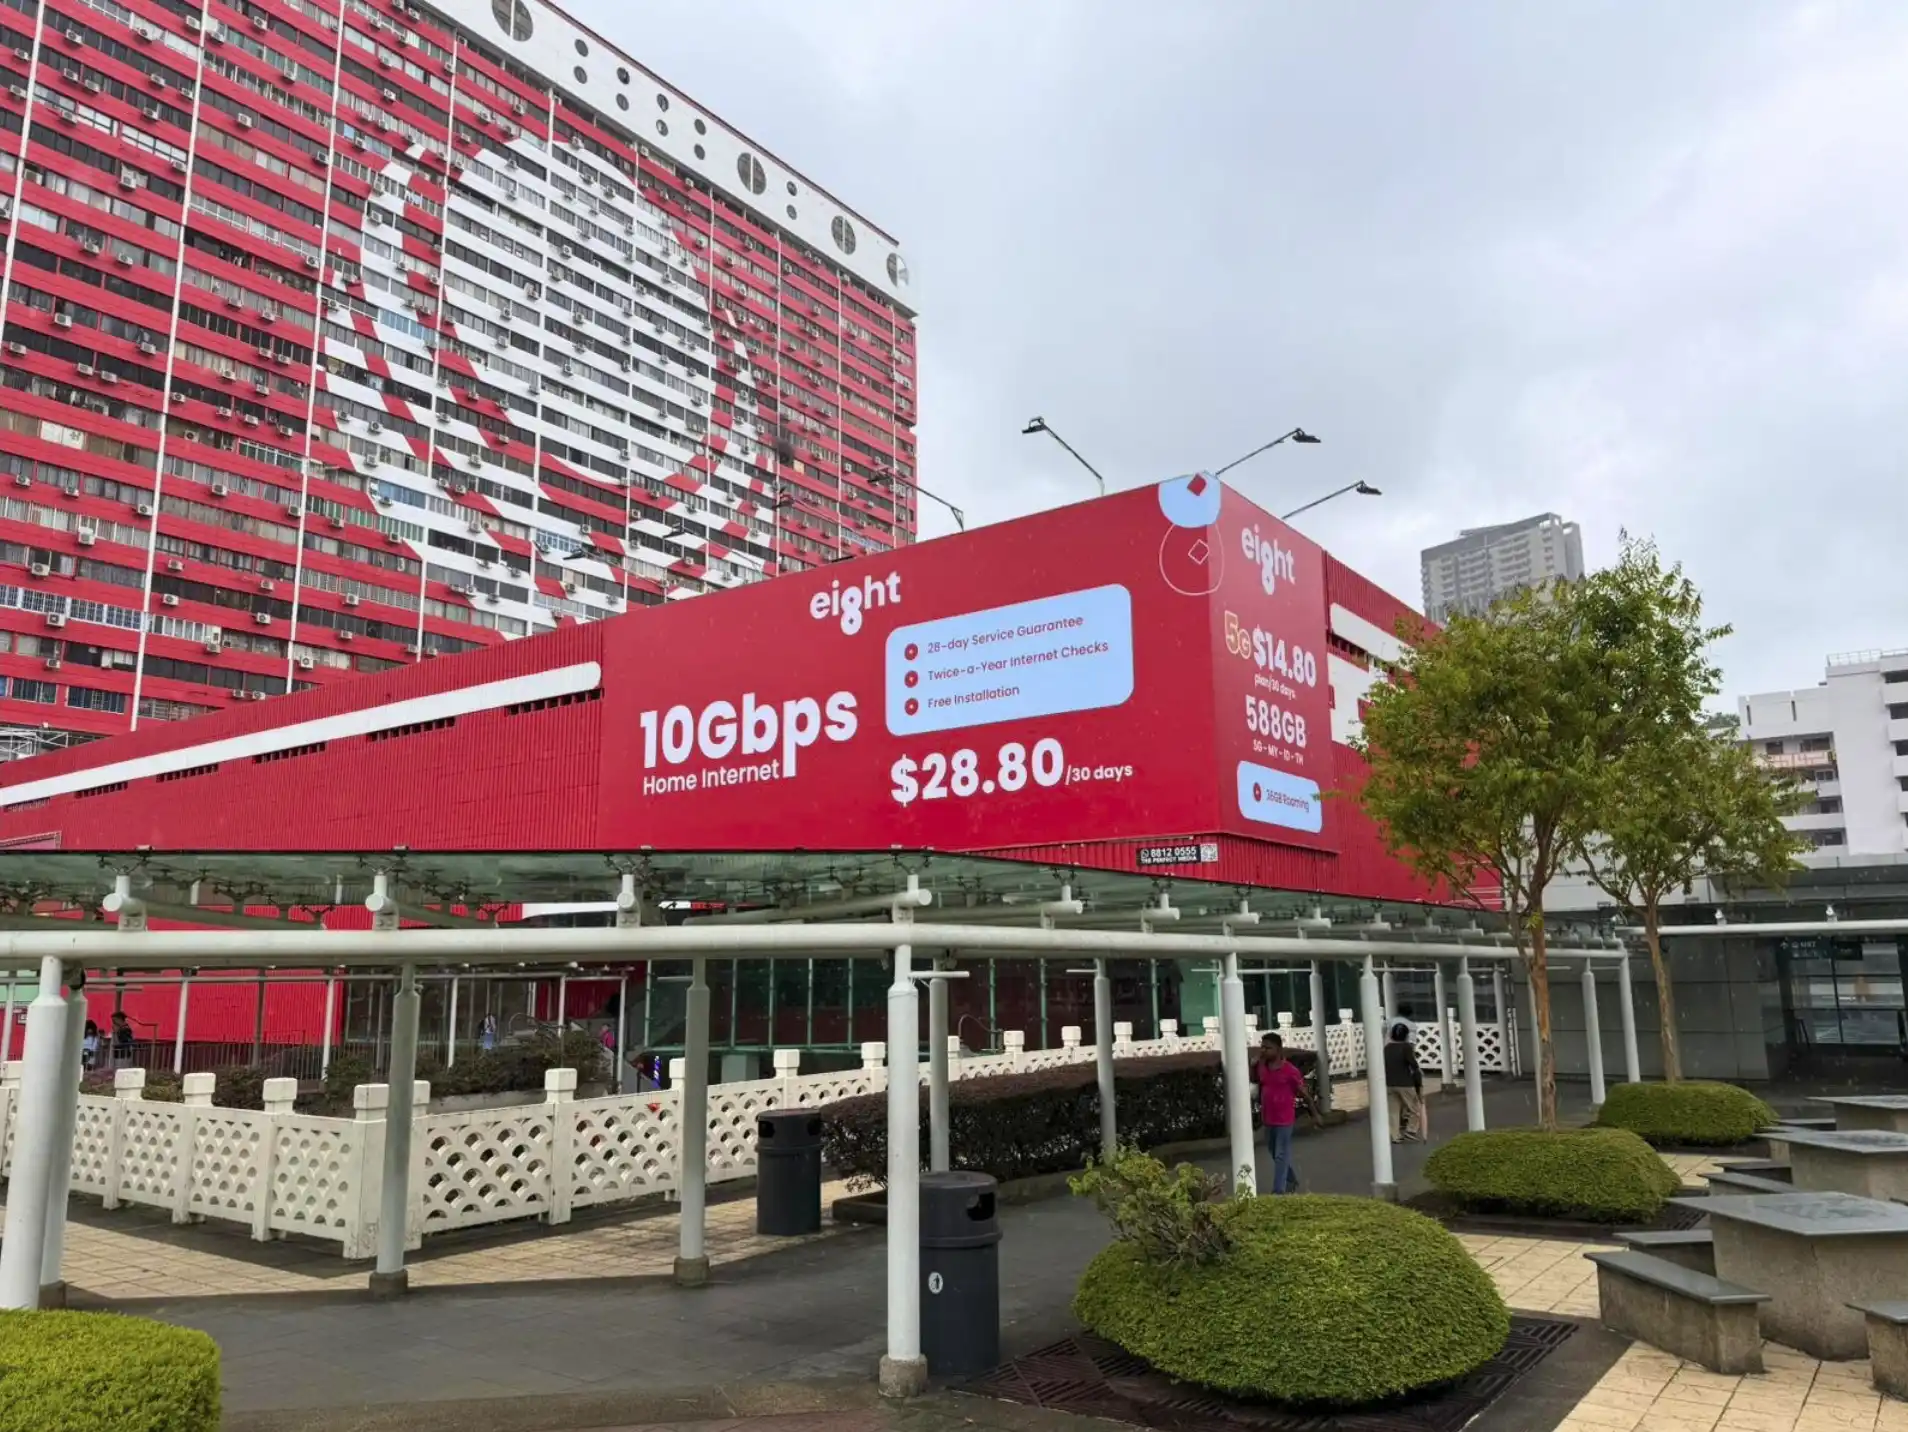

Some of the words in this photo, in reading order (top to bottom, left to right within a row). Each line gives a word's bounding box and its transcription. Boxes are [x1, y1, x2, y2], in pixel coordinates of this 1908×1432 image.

[1241, 523, 1296, 595] eight
[809, 570, 901, 636] eight
[927, 638, 970, 655] 28-day
[971, 628, 1015, 647] Service
[1017, 615, 1084, 636] Guarantee
[927, 658, 1008, 682] Twice-a-Year
[1009, 648, 1059, 668] Internet
[1060, 640, 1109, 659] Checks
[1252, 624, 1316, 687] $14.80
[927, 697, 952, 709] Free
[953, 685, 1020, 706] Installation
[1245, 694, 1306, 748] 588GB
[639, 690, 859, 779] 10Gbps
[643, 773, 697, 795] Home
[702, 759, 780, 788] Internet
[891, 738, 1064, 807] $28.80
[1093, 764, 1133, 781] days
[1174, 846, 1197, 856] 0555
